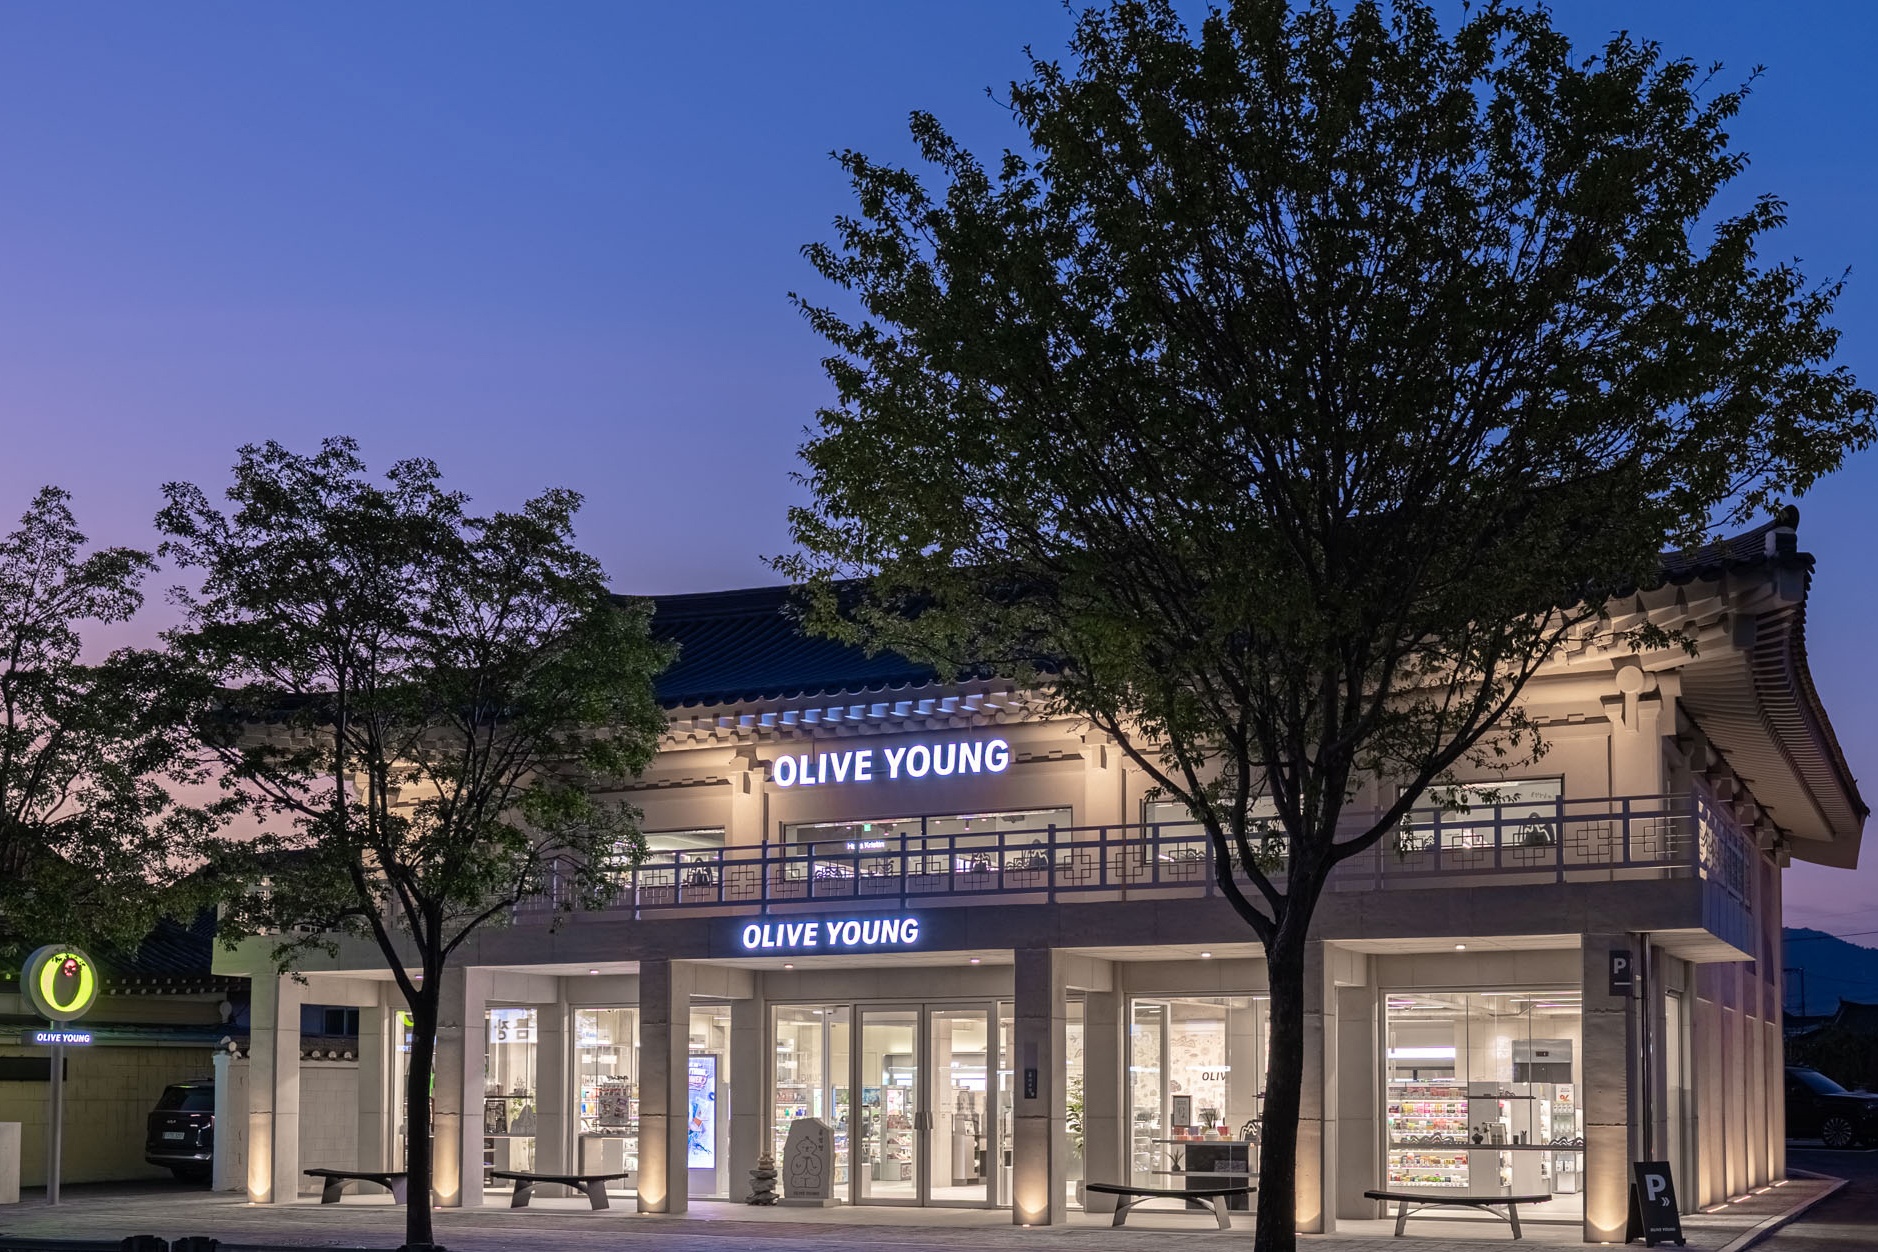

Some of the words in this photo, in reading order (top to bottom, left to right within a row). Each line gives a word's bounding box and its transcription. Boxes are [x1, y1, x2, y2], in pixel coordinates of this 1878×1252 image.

[773, 750, 873, 787] OLIVE
[883, 739, 1009, 779] YOUNG
[743, 921, 819, 949] OLIVE
[826, 918, 919, 945] YOUNG
[1613, 956, 1627, 975] P
[36, 1032, 62, 1042] OLIVE
[62, 1033, 91, 1043] YOUNG
[1645, 1174, 1666, 1201] P
